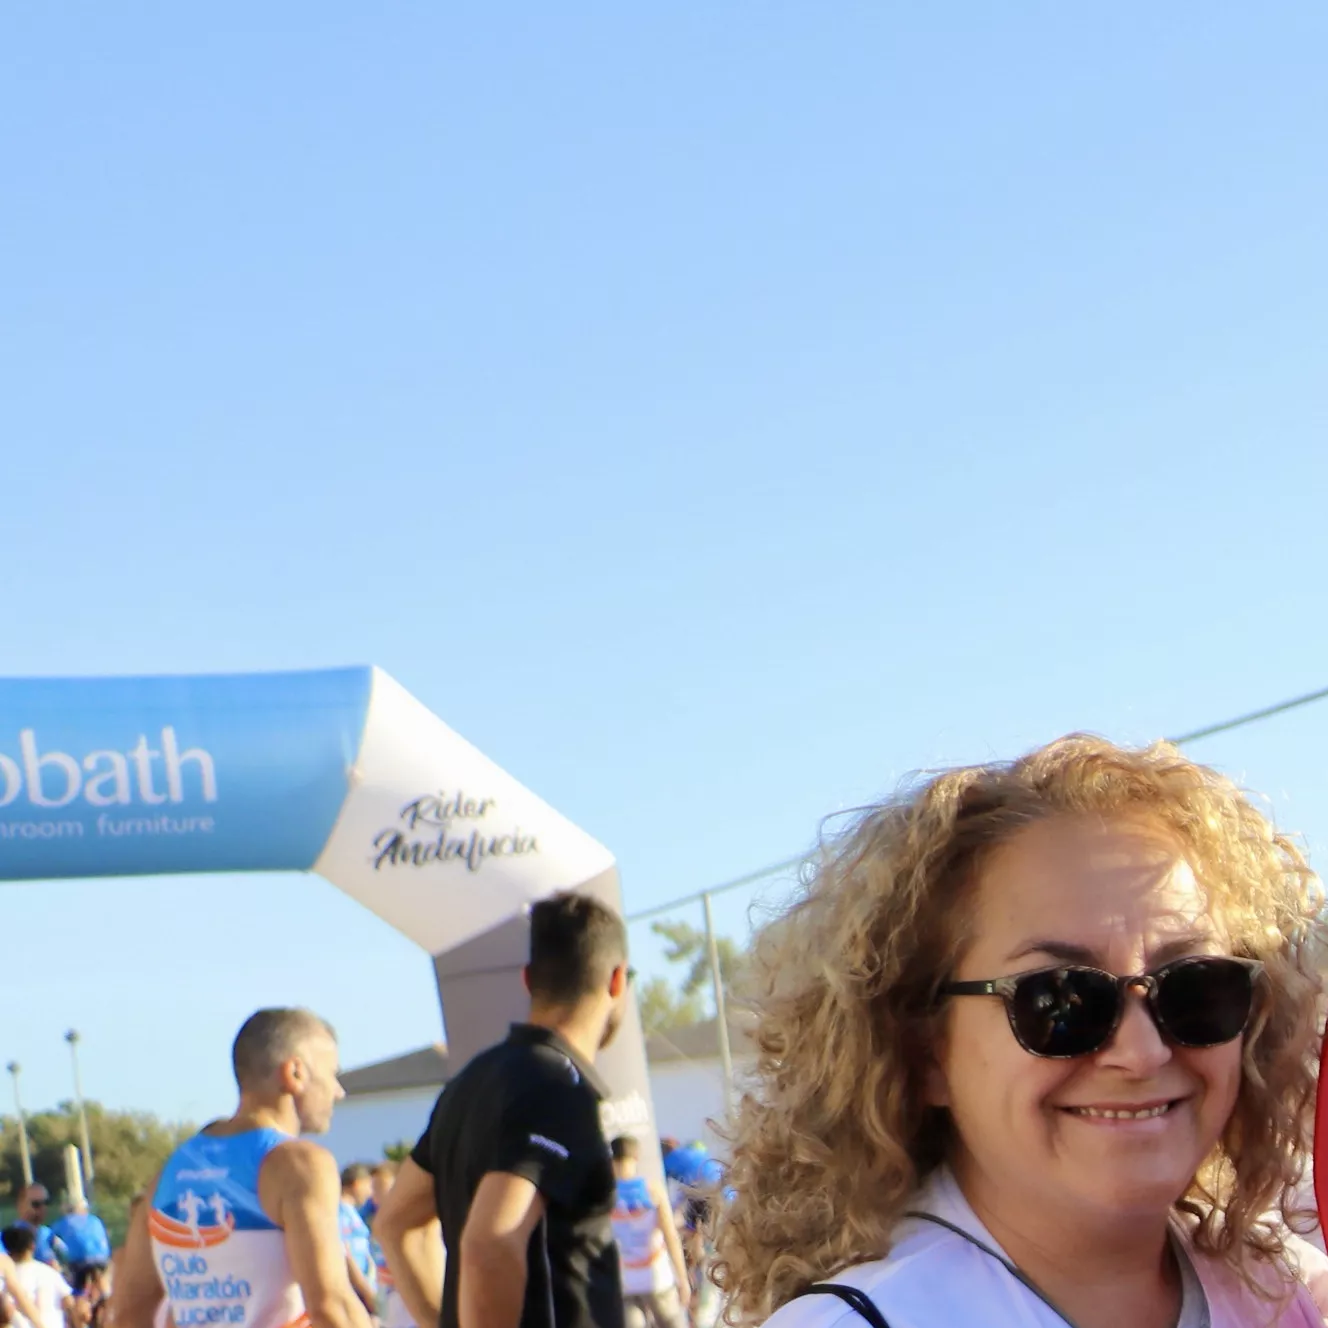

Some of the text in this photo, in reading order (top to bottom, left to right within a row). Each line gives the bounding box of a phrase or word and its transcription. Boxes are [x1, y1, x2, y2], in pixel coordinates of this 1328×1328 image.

[400, 789, 496, 830] Rider
[97, 812, 215, 836] furniture
[161, 1254, 208, 1277] Club
